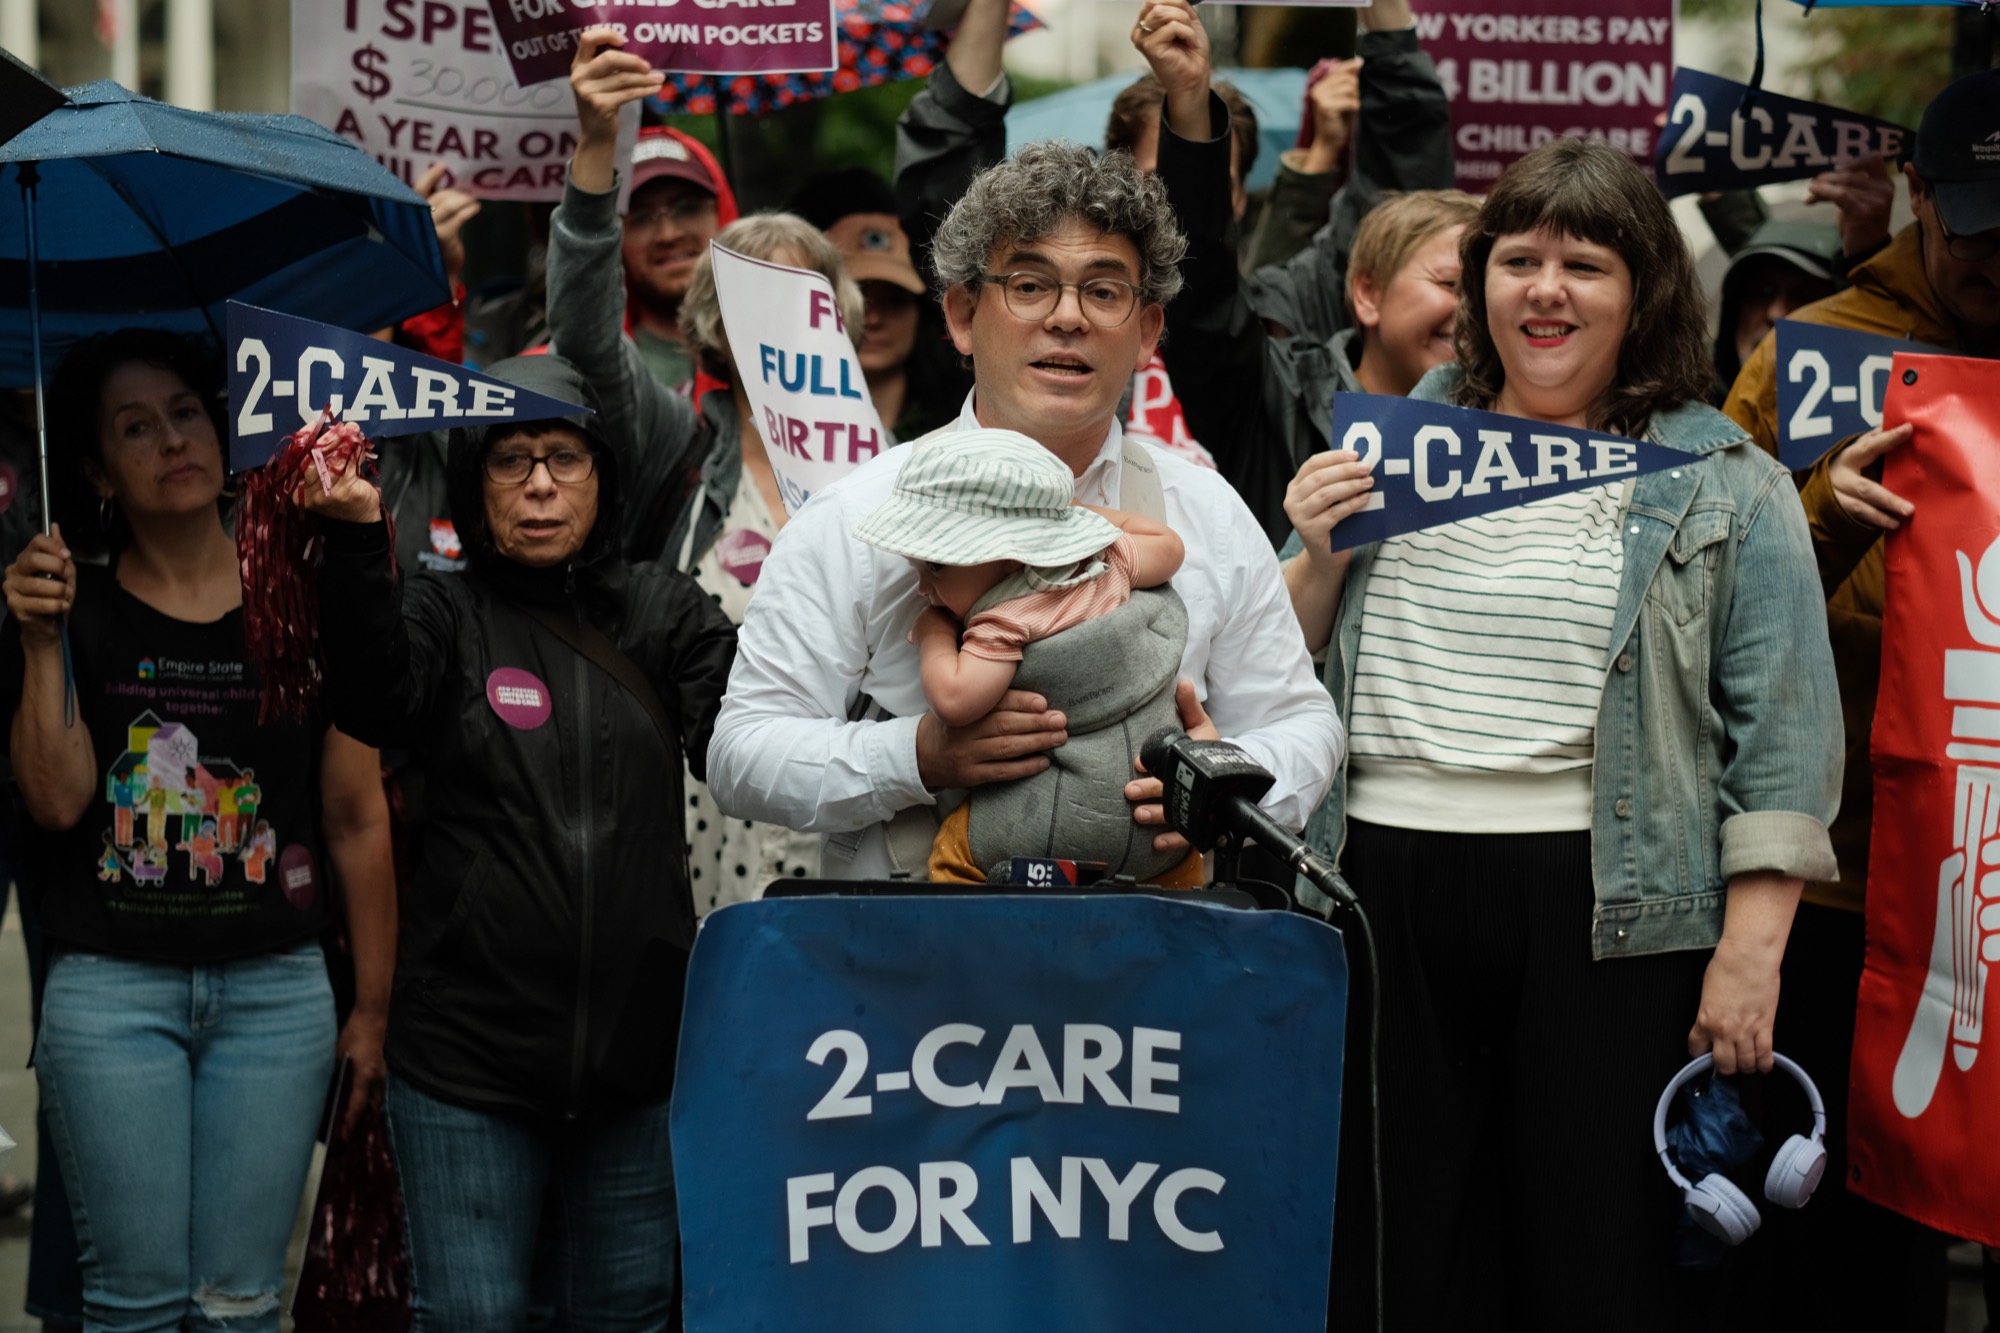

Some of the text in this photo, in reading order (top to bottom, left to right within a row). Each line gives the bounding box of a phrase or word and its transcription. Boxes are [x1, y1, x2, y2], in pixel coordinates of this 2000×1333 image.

[380, 0, 503, 53] SPE
[511, 38, 548, 60] OUT
[548, 31, 571, 52] OF
[634, 23, 700, 45] OWN
[704, 21, 824, 46] POCKETS
[1450, 14, 1603, 44] YORKERS
[1607, 16, 1670, 45] PAY
[352, 41, 393, 104] $
[1467, 59, 1667, 108] BILLION
[334, 108, 365, 142] A
[379, 113, 501, 160] YEAR
[1664, 92, 1905, 175] 2-CARE
[472, 164, 566, 192] CAR
[236, 337, 516, 437] 2-CARE
[759, 342, 863, 401] FULL
[763, 404, 880, 463] BIRTH
[1341, 421, 1638, 512] 2-CARE
[158, 656, 244, 675] Empire State
[1180, 789, 1191, 830] NEWS
[805, 1022, 1182, 1121] 2-CARE
[786, 1156, 1227, 1264] FOR NYC
